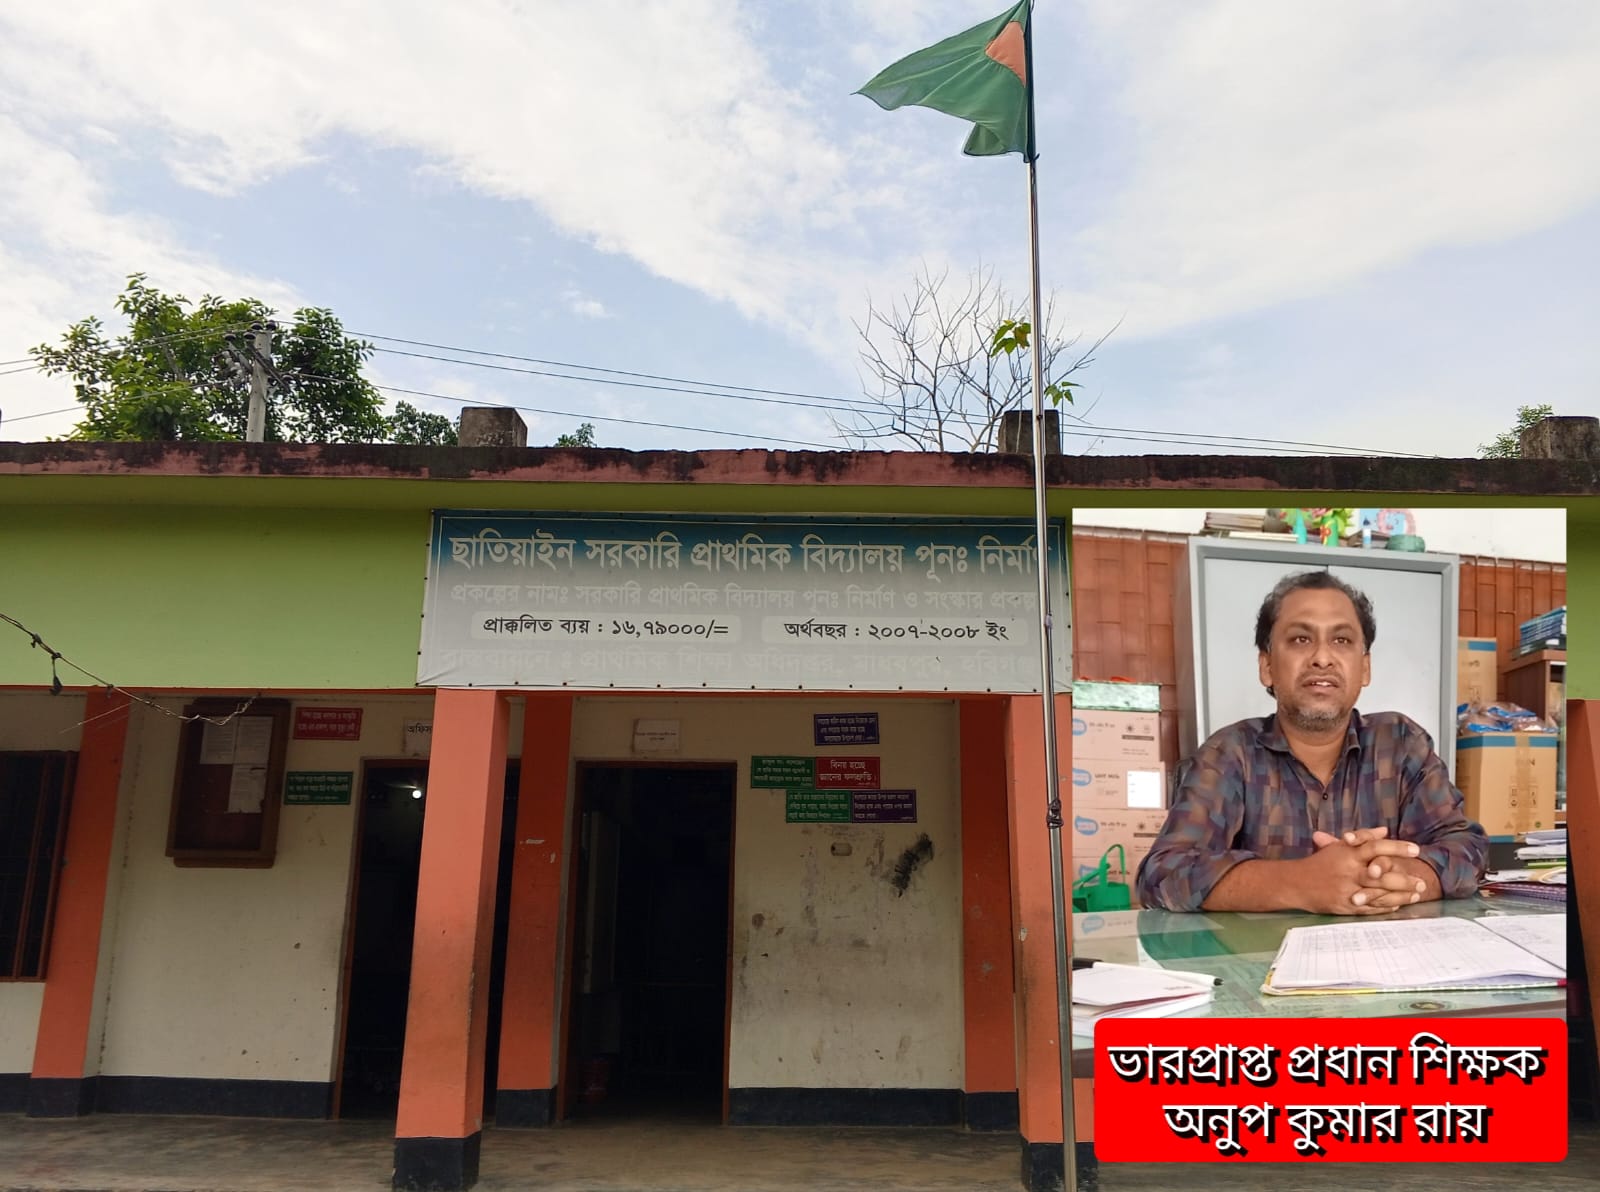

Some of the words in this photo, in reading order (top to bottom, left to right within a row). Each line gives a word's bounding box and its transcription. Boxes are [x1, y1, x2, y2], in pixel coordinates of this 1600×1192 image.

[449, 527, 576, 569] ছাতিয়াইন
[584, 531, 682, 569] সরকারি
[691, 533, 792, 572] প্রাথমিক
[800, 533, 904, 574] বিদ্যালয়
[915, 542, 967, 582] পূনঃ
[976, 535, 1051, 575] নির্মা
[575, 580, 642, 605] সরকারি
[648, 582, 718, 606] প্রাথমিক
[723, 583, 795, 608] বিদ্যালয়
[846, 584, 896, 609] নির্মাণ
[904, 592, 918, 609] ও
[483, 614, 552, 634] প্রাক্কলিত
[560, 617, 590, 635] ব্যয়
[612, 619, 729, 638] ১৬,৭৯০০০/=
[784, 618, 847, 638] অর্থবছর
[869, 623, 980, 640] ২০০৭-২০০৮
[986, 620, 1009, 640] ইং
